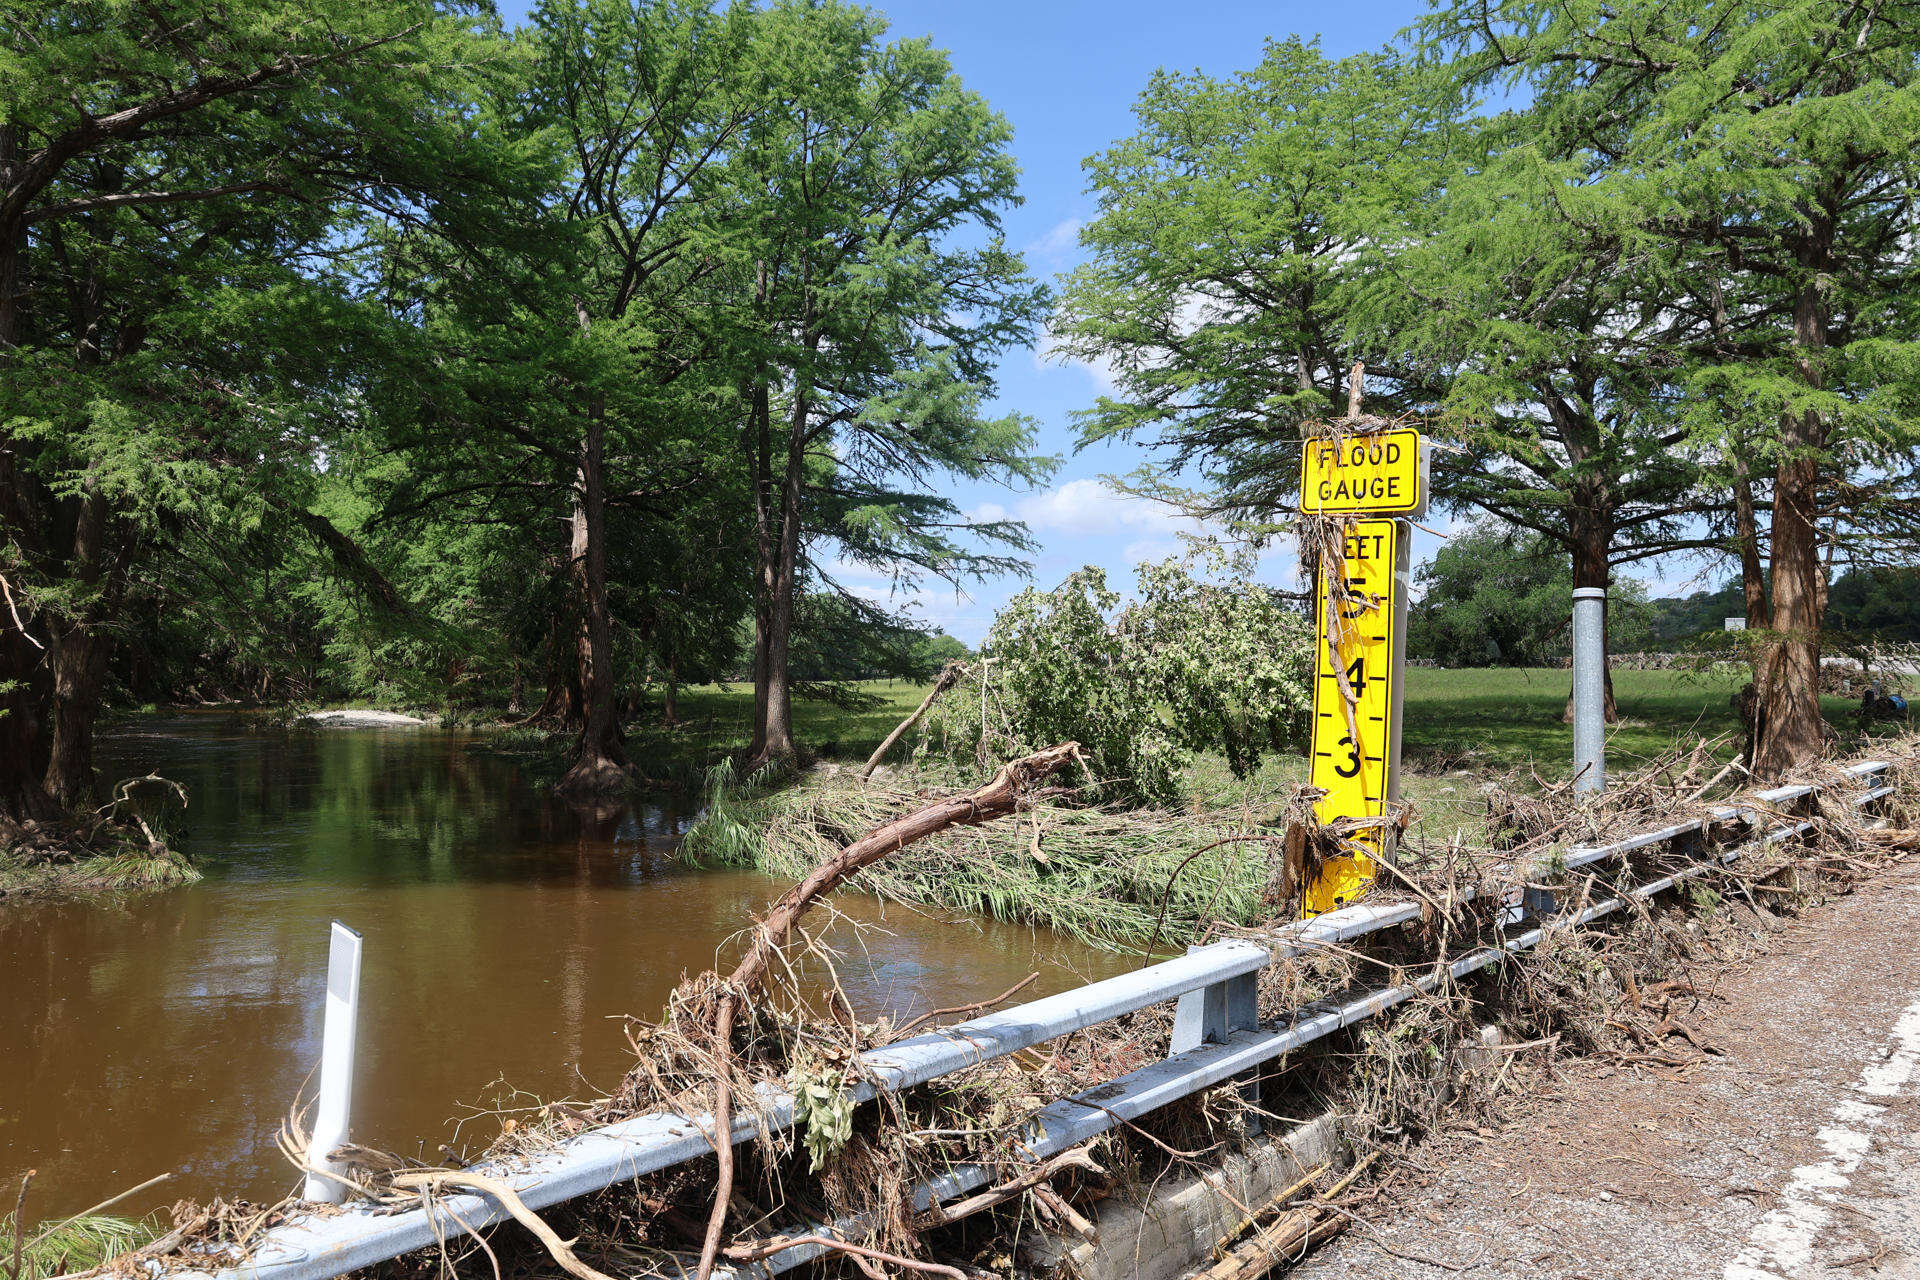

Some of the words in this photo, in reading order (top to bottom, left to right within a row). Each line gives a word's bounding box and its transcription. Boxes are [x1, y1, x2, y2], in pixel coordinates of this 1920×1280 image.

[1319, 443, 1400, 468] FLOOD
[1319, 476, 1400, 501] GAUGE
[1342, 535, 1384, 560] EET
[1342, 577, 1367, 619] 5
[1338, 657, 1366, 698] 4
[1335, 736, 1361, 778] 3
